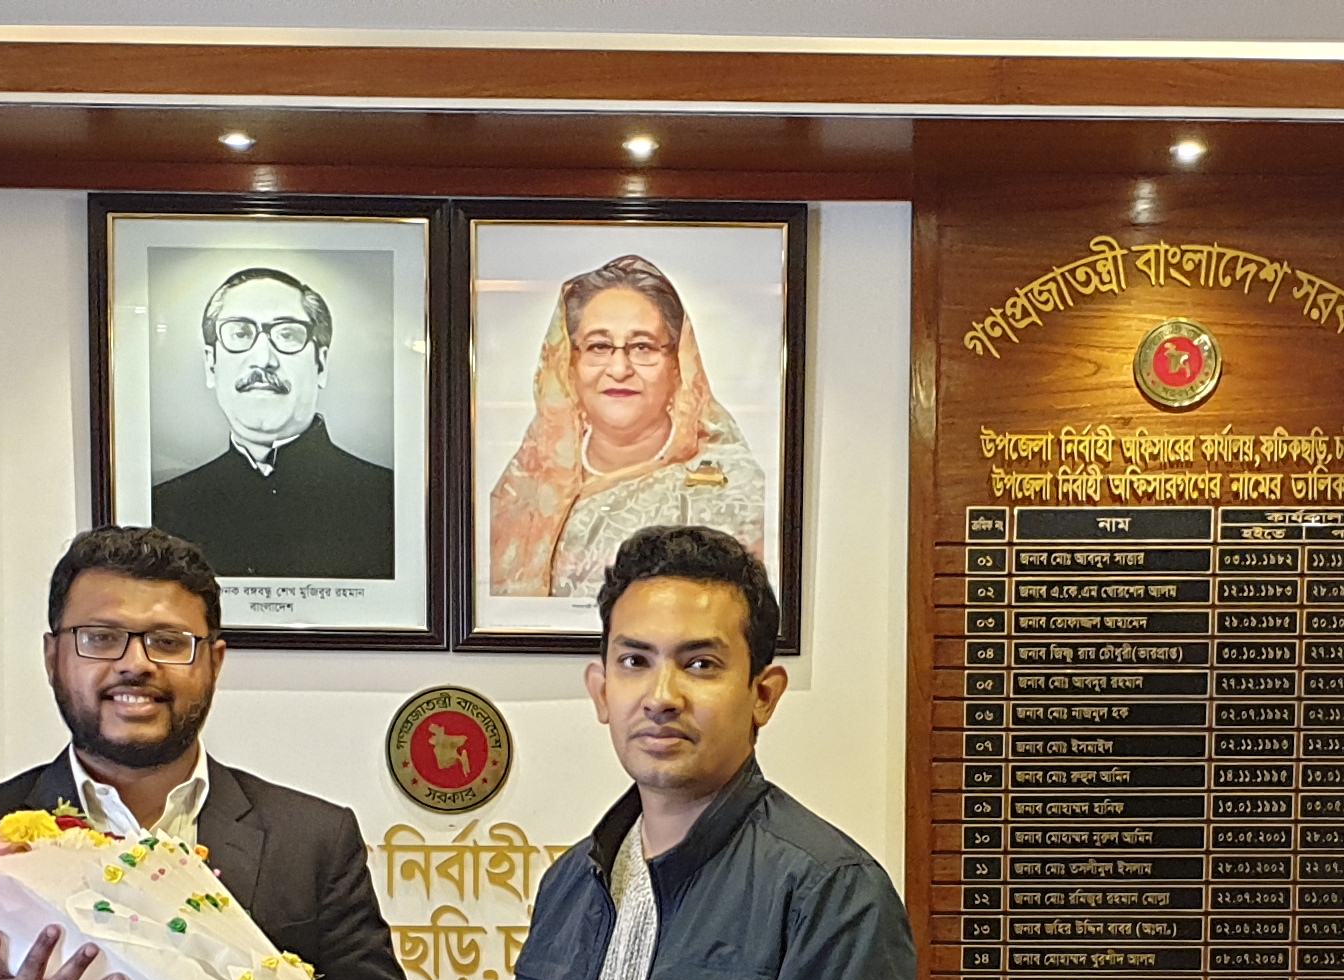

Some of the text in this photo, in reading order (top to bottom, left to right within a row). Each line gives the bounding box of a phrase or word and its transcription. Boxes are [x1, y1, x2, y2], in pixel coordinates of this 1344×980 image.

[964, 235, 1129, 359] গণপ্রজাতন্ত্রী
[1132, 240, 1290, 303] বাংলাদেশ
[980, 425, 1054, 461] উপজেলা
[1060, 424, 1115, 462] নির্বাহী
[1120, 426, 1195, 462] অফিসারের
[991, 464, 1053, 500] উপজেলা
[1057, 464, 1104, 501] নির্বাহী
[1108, 464, 1223, 501] অফিসারগণের
[1229, 471, 1284, 500] নামের
[1265, 510, 1344, 525] কার্যকাল
[1096, 516, 1132, 533] নাম
[1241, 526, 1286, 540] হইতে
[976, 554, 994, 568] ০১
[1019, 551, 1049, 567] জনাব
[276, 587, 296, 597] শেখ
[299, 584, 331, 599] মুজিবুর
[335, 588, 365, 598] রহমান
[977, 586, 995, 599] ০২
[250, 602, 294, 612] বাংলাদেশ
[976, 617, 996, 628] ০৩
[977, 647, 995, 659] ০৪
[976, 679, 994, 691] ০৫
[1017, 676, 1046, 689] জনাব
[974, 709, 994, 721] ০৬
[1015, 706, 1044, 720] জনাব
[1111, 706, 1130, 720] হক
[455, 696, 502, 749] বাংলাদেশ
[975, 740, 993, 752] ০৭
[1015, 741, 1044, 754] জনাব
[973, 771, 993, 783] ০৮
[1015, 770, 1044, 784] জনাব
[1098, 766, 1131, 783] আমিন
[425, 786, 476, 804] সরকার
[973, 801, 992, 813] ০৯
[1014, 802, 1044, 815] জনাব
[974, 832, 991, 844] ১০
[1014, 831, 1043, 844] জনাব
[1120, 827, 1154, 844] আমিন
[377, 819, 540, 902] নির্বাহী
[975, 863, 989, 875] ১১
[974, 893, 990, 906] ১২
[973, 923, 991, 936] ১৩
[974, 953, 990, 965] ১৪
